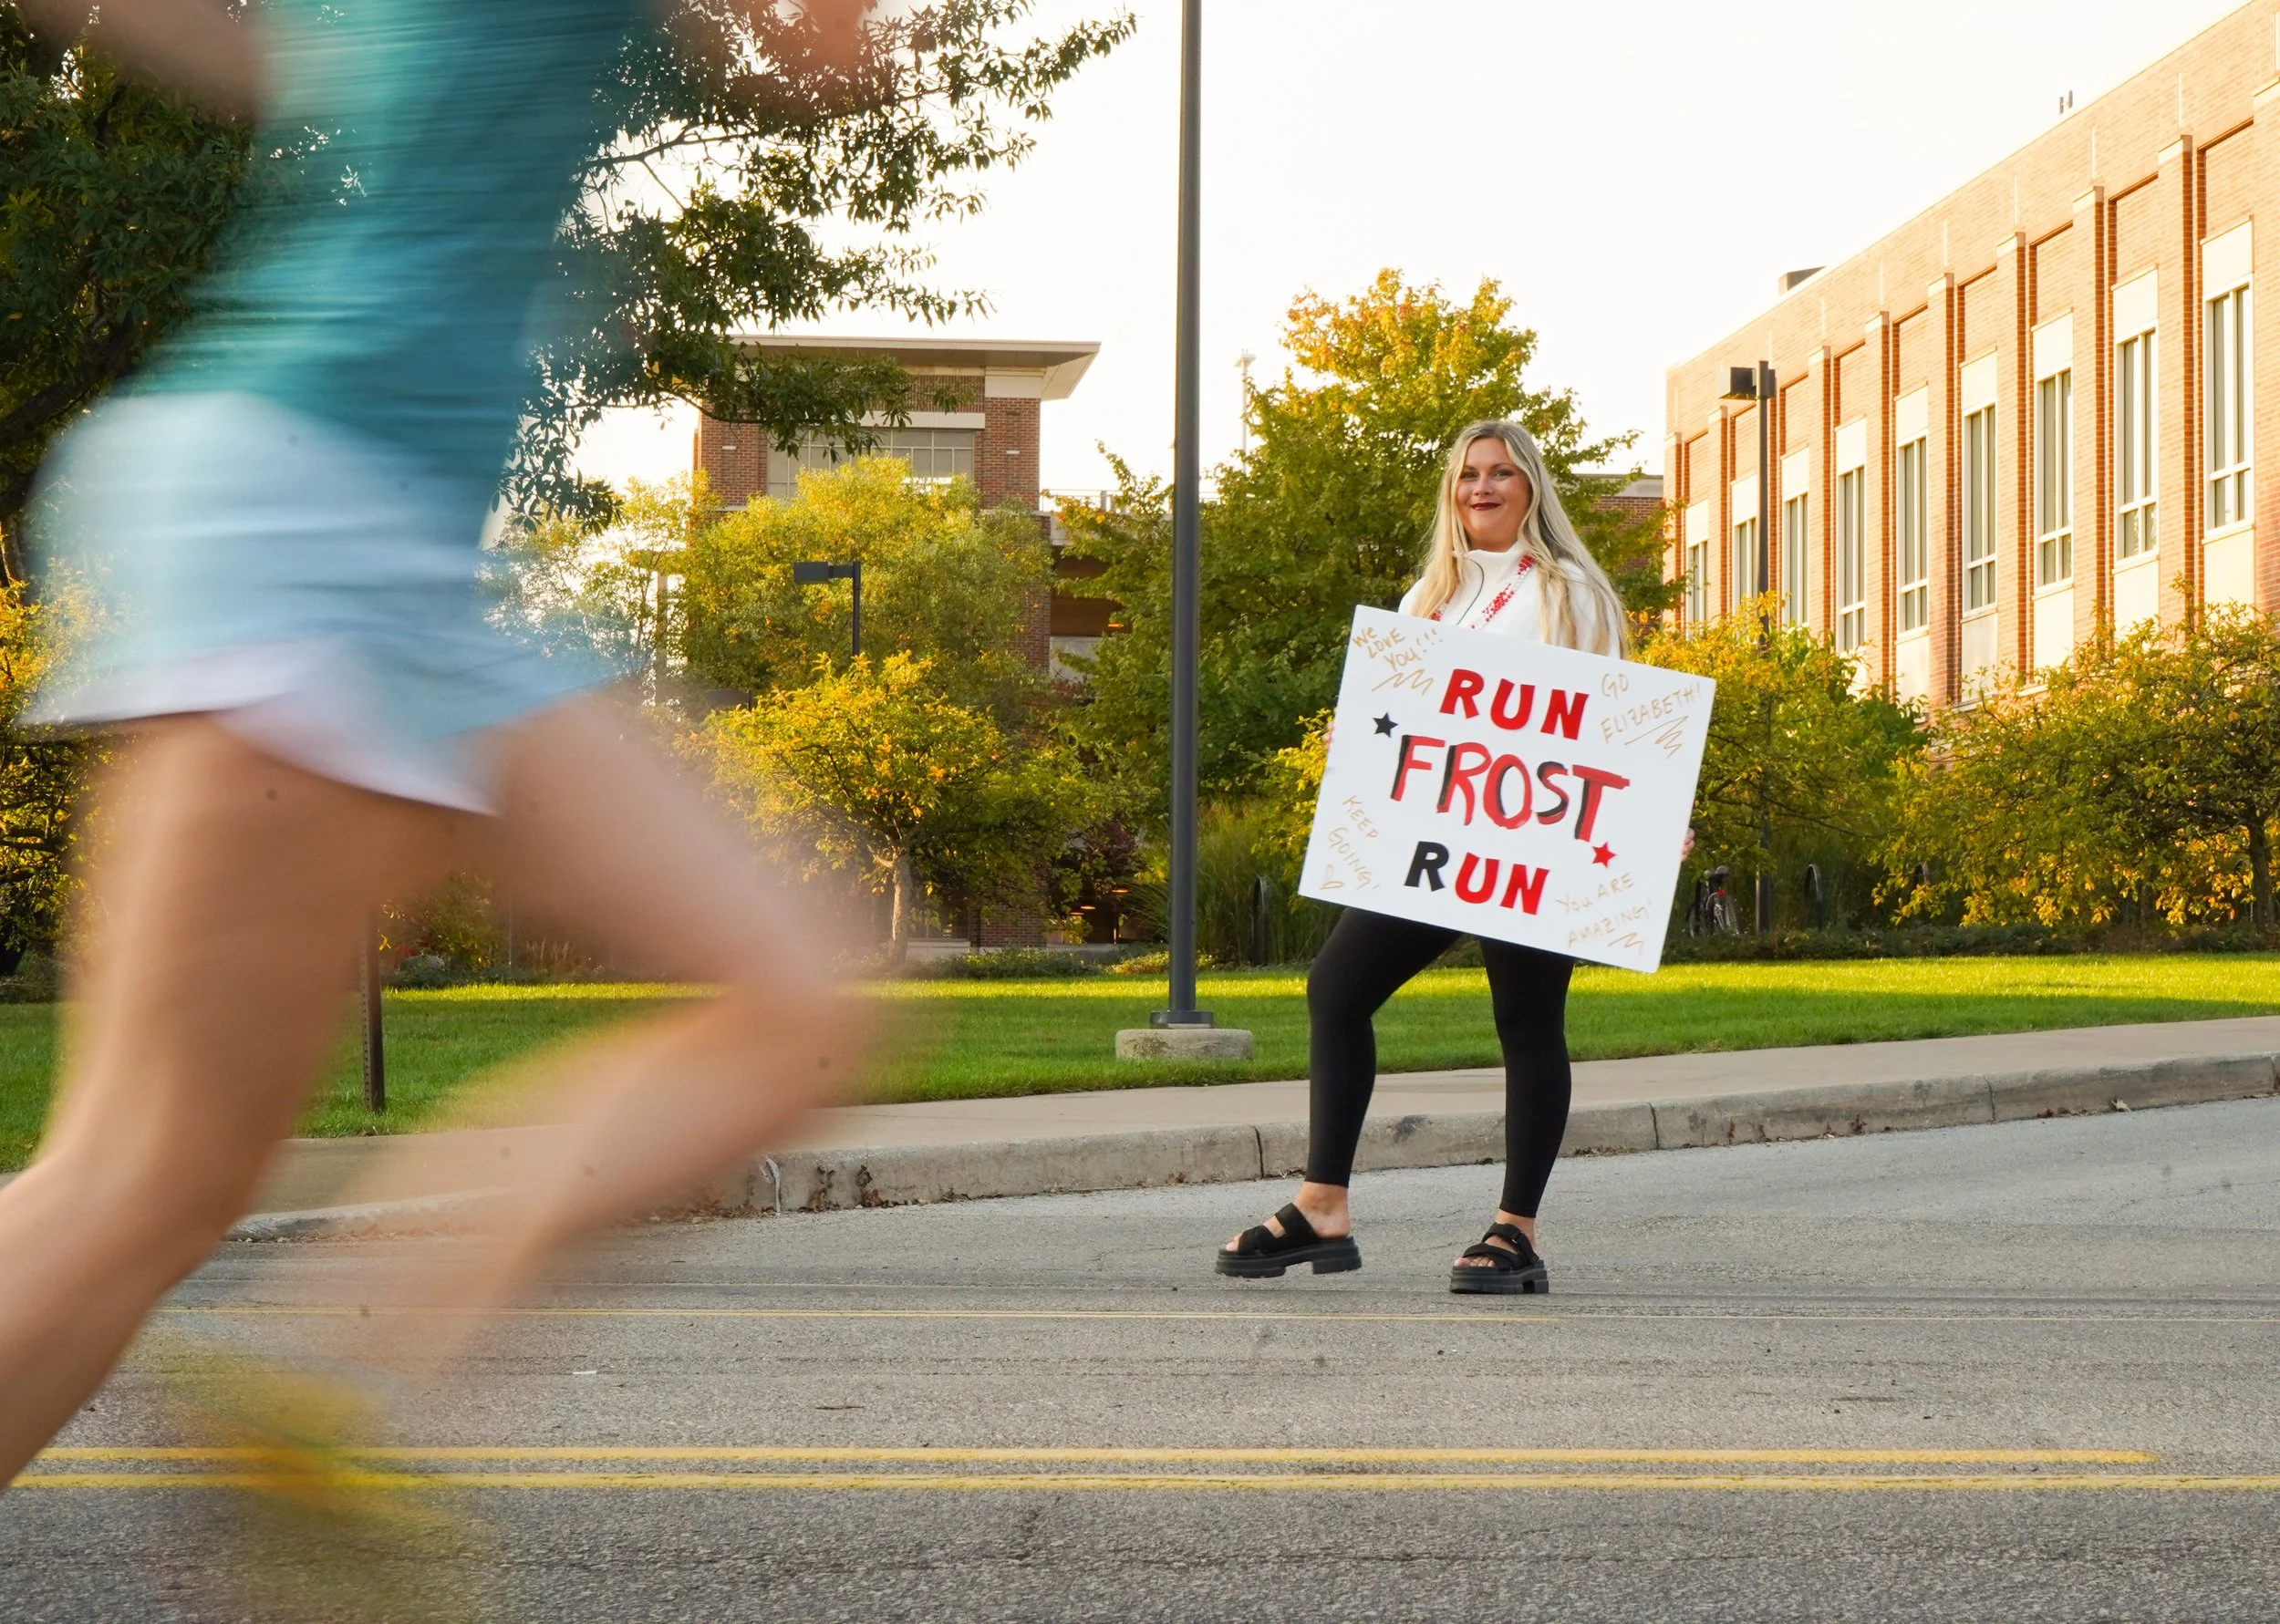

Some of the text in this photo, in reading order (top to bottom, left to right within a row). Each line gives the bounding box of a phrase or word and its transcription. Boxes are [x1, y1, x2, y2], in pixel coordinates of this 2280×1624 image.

[1367, 627, 1407, 658] LOVE
[1439, 668, 1590, 740] RUN
[1601, 673, 1629, 700] GO
[1601, 681, 1702, 744] ELIZABETH!
[1342, 795, 1379, 839] KEEP
[1390, 734, 1631, 843] FROST
[1328, 827, 1382, 891] GOING!
[1404, 841, 1550, 915] RUN
[1597, 873, 1634, 899] ARE
